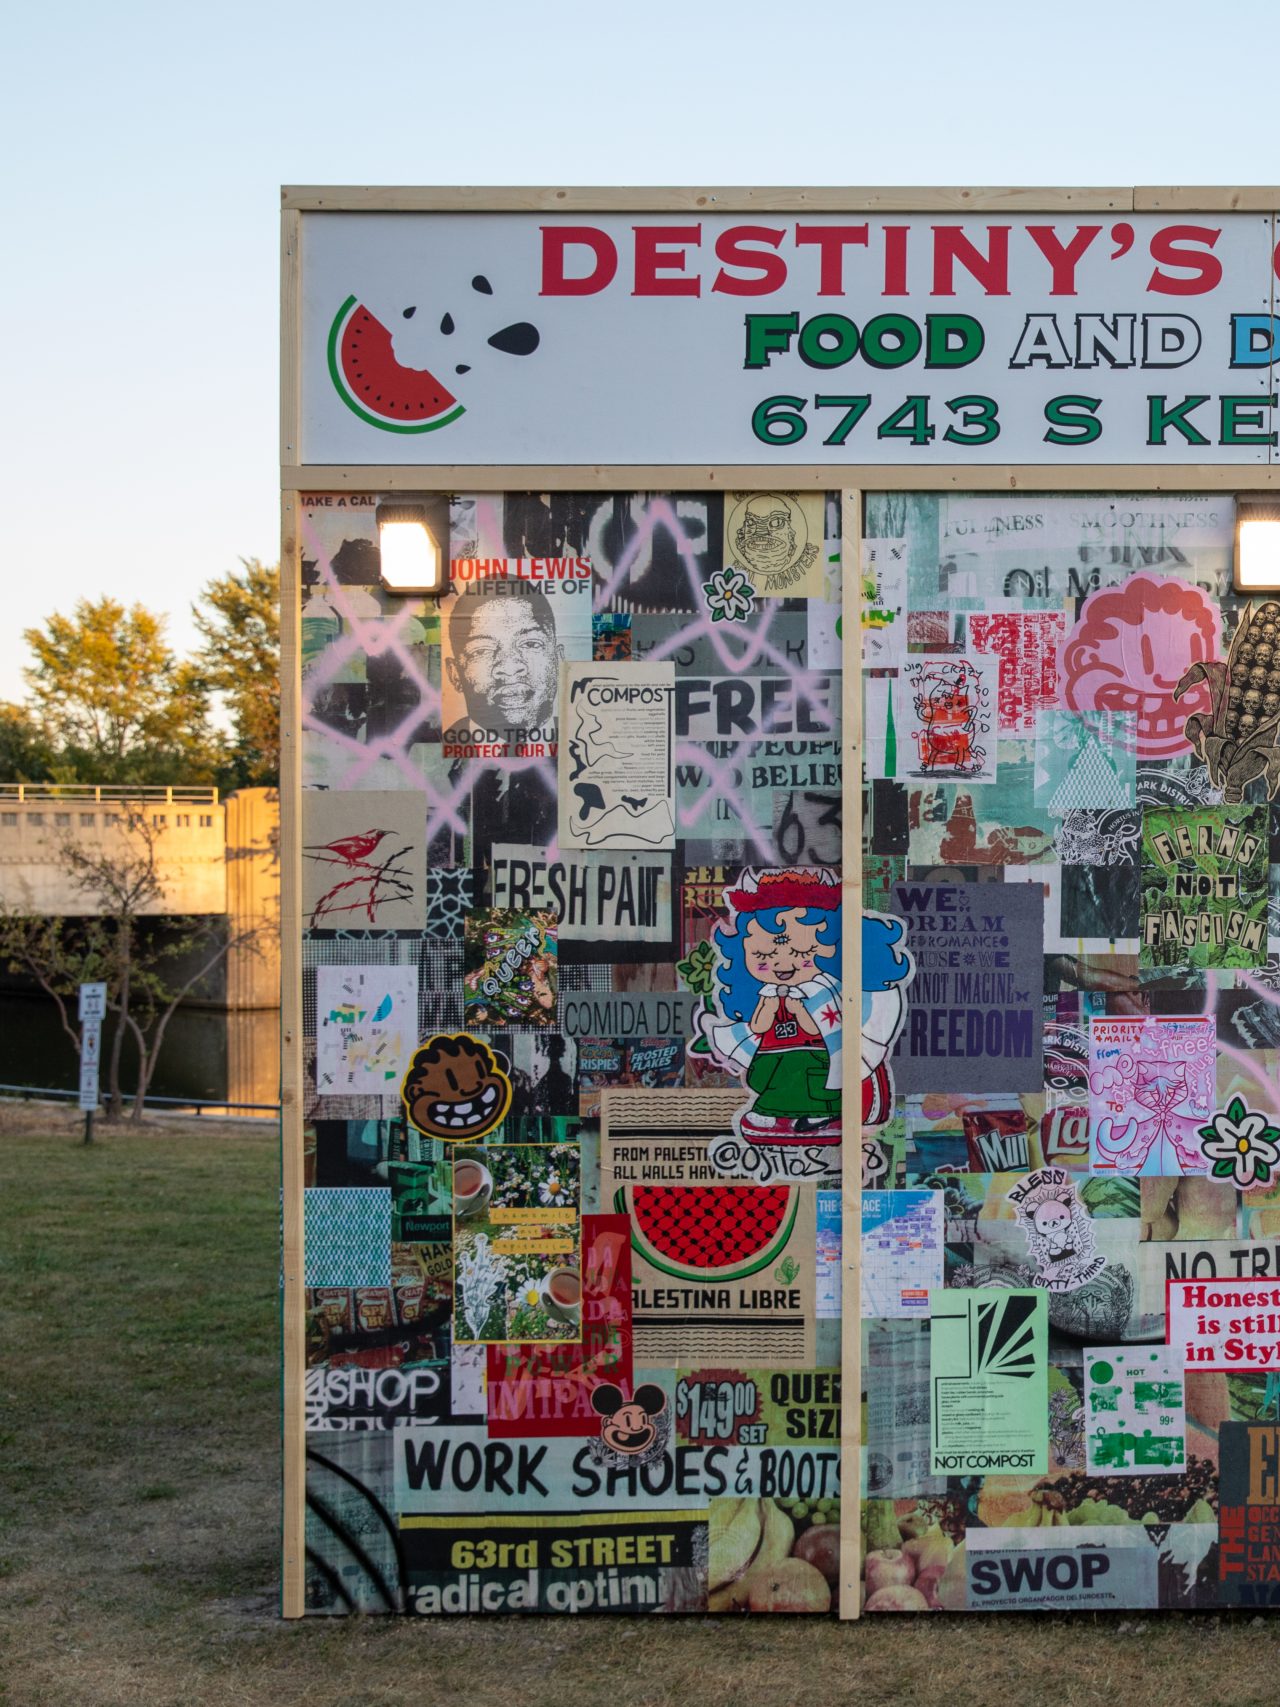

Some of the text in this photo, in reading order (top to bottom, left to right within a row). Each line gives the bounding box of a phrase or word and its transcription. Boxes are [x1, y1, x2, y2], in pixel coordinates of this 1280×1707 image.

[538, 222, 1224, 299] DESTINY'S
[744, 311, 986, 371] FOOD
[1008, 312, 1203, 371] AND
[751, 393, 1002, 446] 6743
[1043, 393, 1104, 446] S
[337, 497, 347, 507] A
[448, 556, 592, 580] JOHN LEWIS
[449, 579, 590, 596] A LIFETIME OF
[942, 665, 984, 680] CRAZY
[587, 687, 676, 707] COMPOST
[675, 679, 831, 736] FREE
[444, 728, 500, 743] GOOD
[443, 744, 508, 759] PROTECT
[514, 744, 545, 758] OUR
[751, 763, 842, 790] BELIE
[1136, 781, 1157, 791] ARK
[1153, 825, 1260, 867] FERNS
[493, 858, 588, 926] FRESH
[1175, 874, 1236, 897] NOT
[896, 887, 957, 912] WE
[901, 915, 1005, 932] DREAM
[1144, 910, 1267, 952] FASCISM
[928, 935, 999, 948] ROMANCE
[978, 951, 1010, 968] WE
[907, 972, 1015, 1005] NNOT IMAGINE
[565, 1001, 684, 1036] COMIDA DE
[775, 1021, 798, 1040] 23
[894, 1008, 1034, 1058] FREEDOM
[1093, 1024, 1145, 1035] PRIORITY
[1104, 1035, 1131, 1043] MAIL
[580, 1058, 619, 1071] RISPIES
[630, 1046, 678, 1064] FROSTED
[631, 1056, 673, 1073] FLAKES
[613, 1146, 712, 1162] FROM PALESTI
[613, 1164, 637, 1180] ALL
[641, 1164, 685, 1180] WALLS
[1008, 1169, 1065, 1204] BLESS
[818, 1199, 837, 1213] THE
[404, 1220, 451, 1234] Newport
[1034, 1256, 1106, 1289] SIXTY-THIRD
[1165, 1251, 1217, 1279] NO
[630, 1288, 801, 1309] ALESTINA LIBRE
[1197, 1314, 1221, 1335] is
[1185, 1340, 1215, 1362] in
[1126, 1368, 1146, 1377] HOT
[738, 1424, 768, 1445] SET
[404, 1438, 550, 1499] WORK
[571, 1445, 729, 1498] SHOES
[935, 1455, 966, 1469] NOT
[966, 1453, 1036, 1469] COMPOST
[451, 1534, 676, 1569] 63rd STREET
[1218, 1505, 1246, 1582] THE
[971, 1553, 1111, 1596] SWOP
[981, 1597, 1018, 1607] PROYECTO
